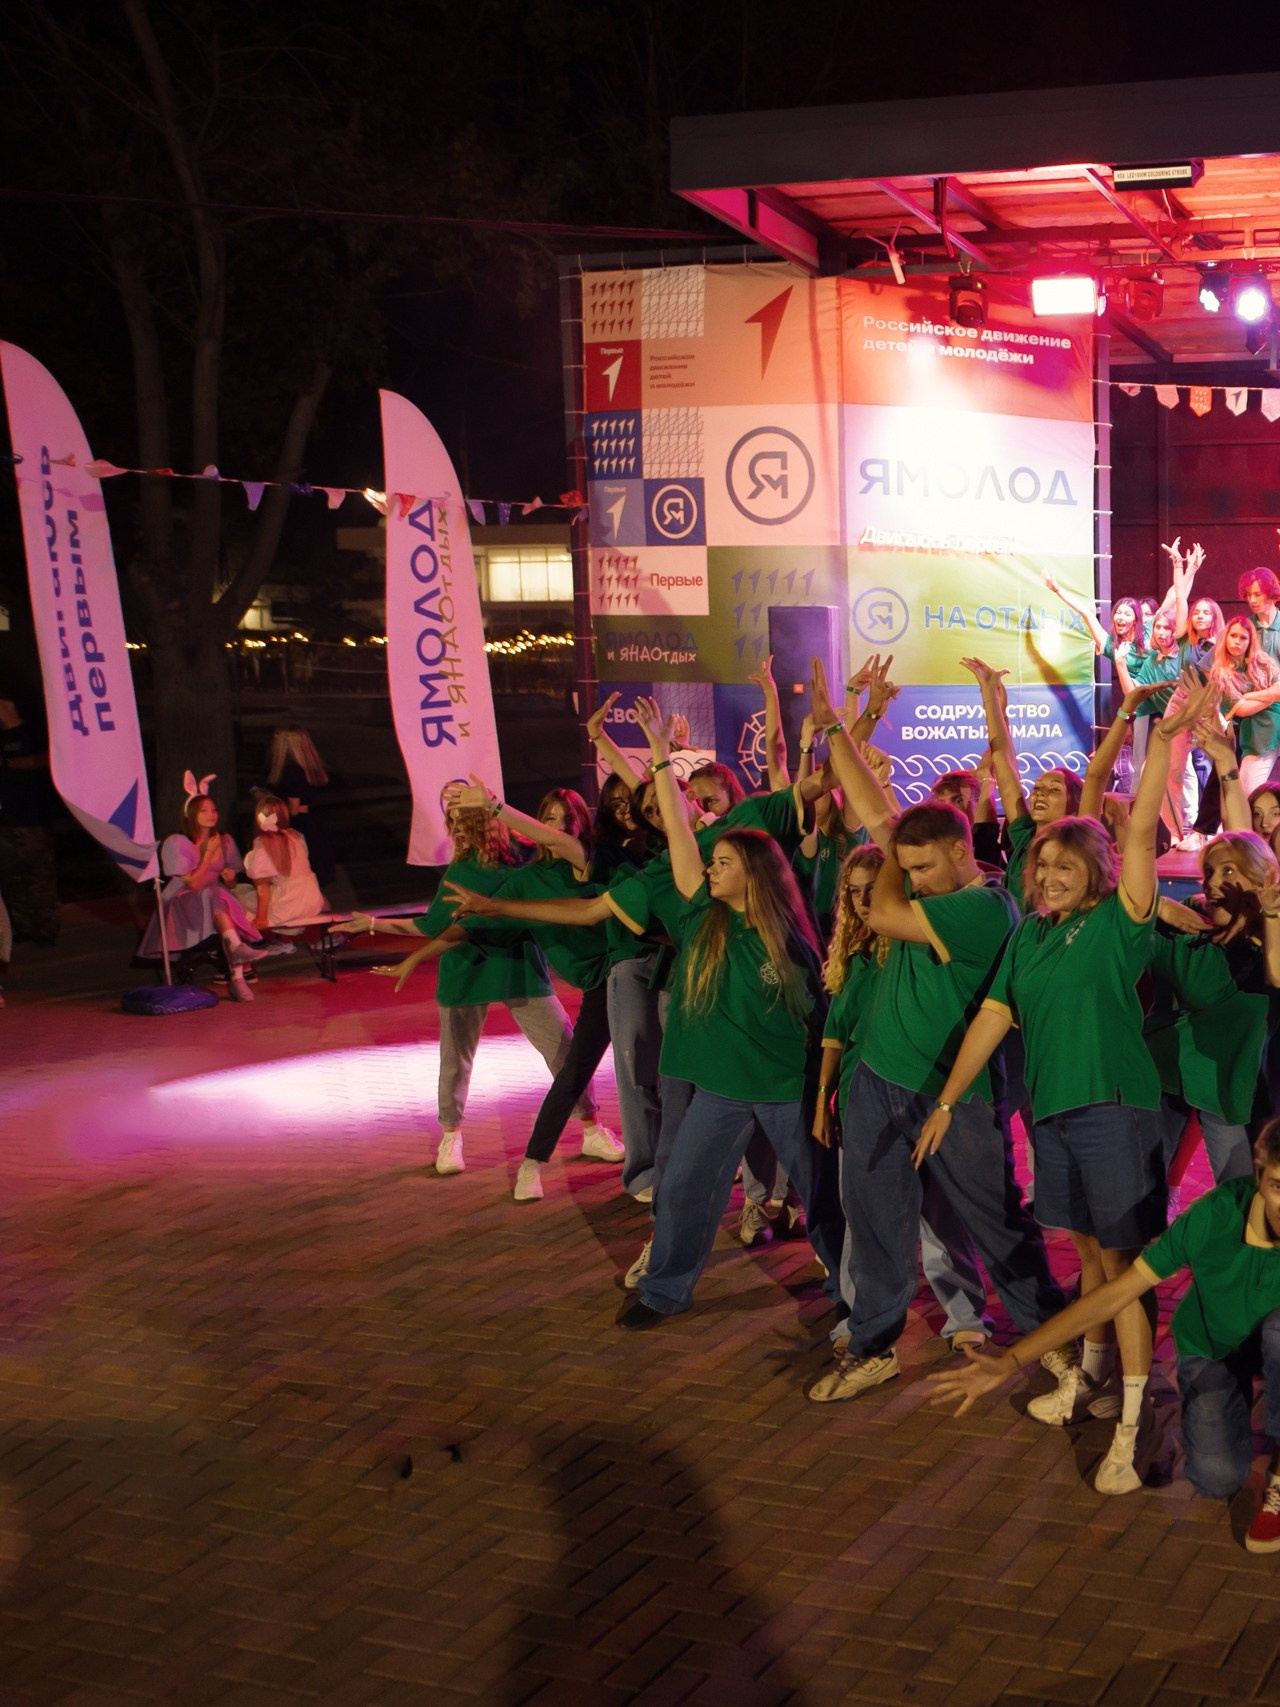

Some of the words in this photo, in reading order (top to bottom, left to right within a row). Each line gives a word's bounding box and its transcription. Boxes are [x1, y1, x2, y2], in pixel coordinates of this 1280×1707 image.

[863, 315, 978, 339] Российское
[981, 328, 1072, 349] движение
[939, 345, 1034, 365] молодёжи
[858, 458, 1078, 506] ЯМОЛОД
[650, 573, 704, 590] Первые
[67, 510, 116, 732] первым
[408, 499, 457, 748] ЯМОЛОД
[923, 605, 967, 630] НА
[607, 651, 615, 661] и
[604, 707, 640, 724] СВО
[914, 703, 1051, 721] СОДРУСТВО
[1008, 723, 1063, 739] МАЛА
